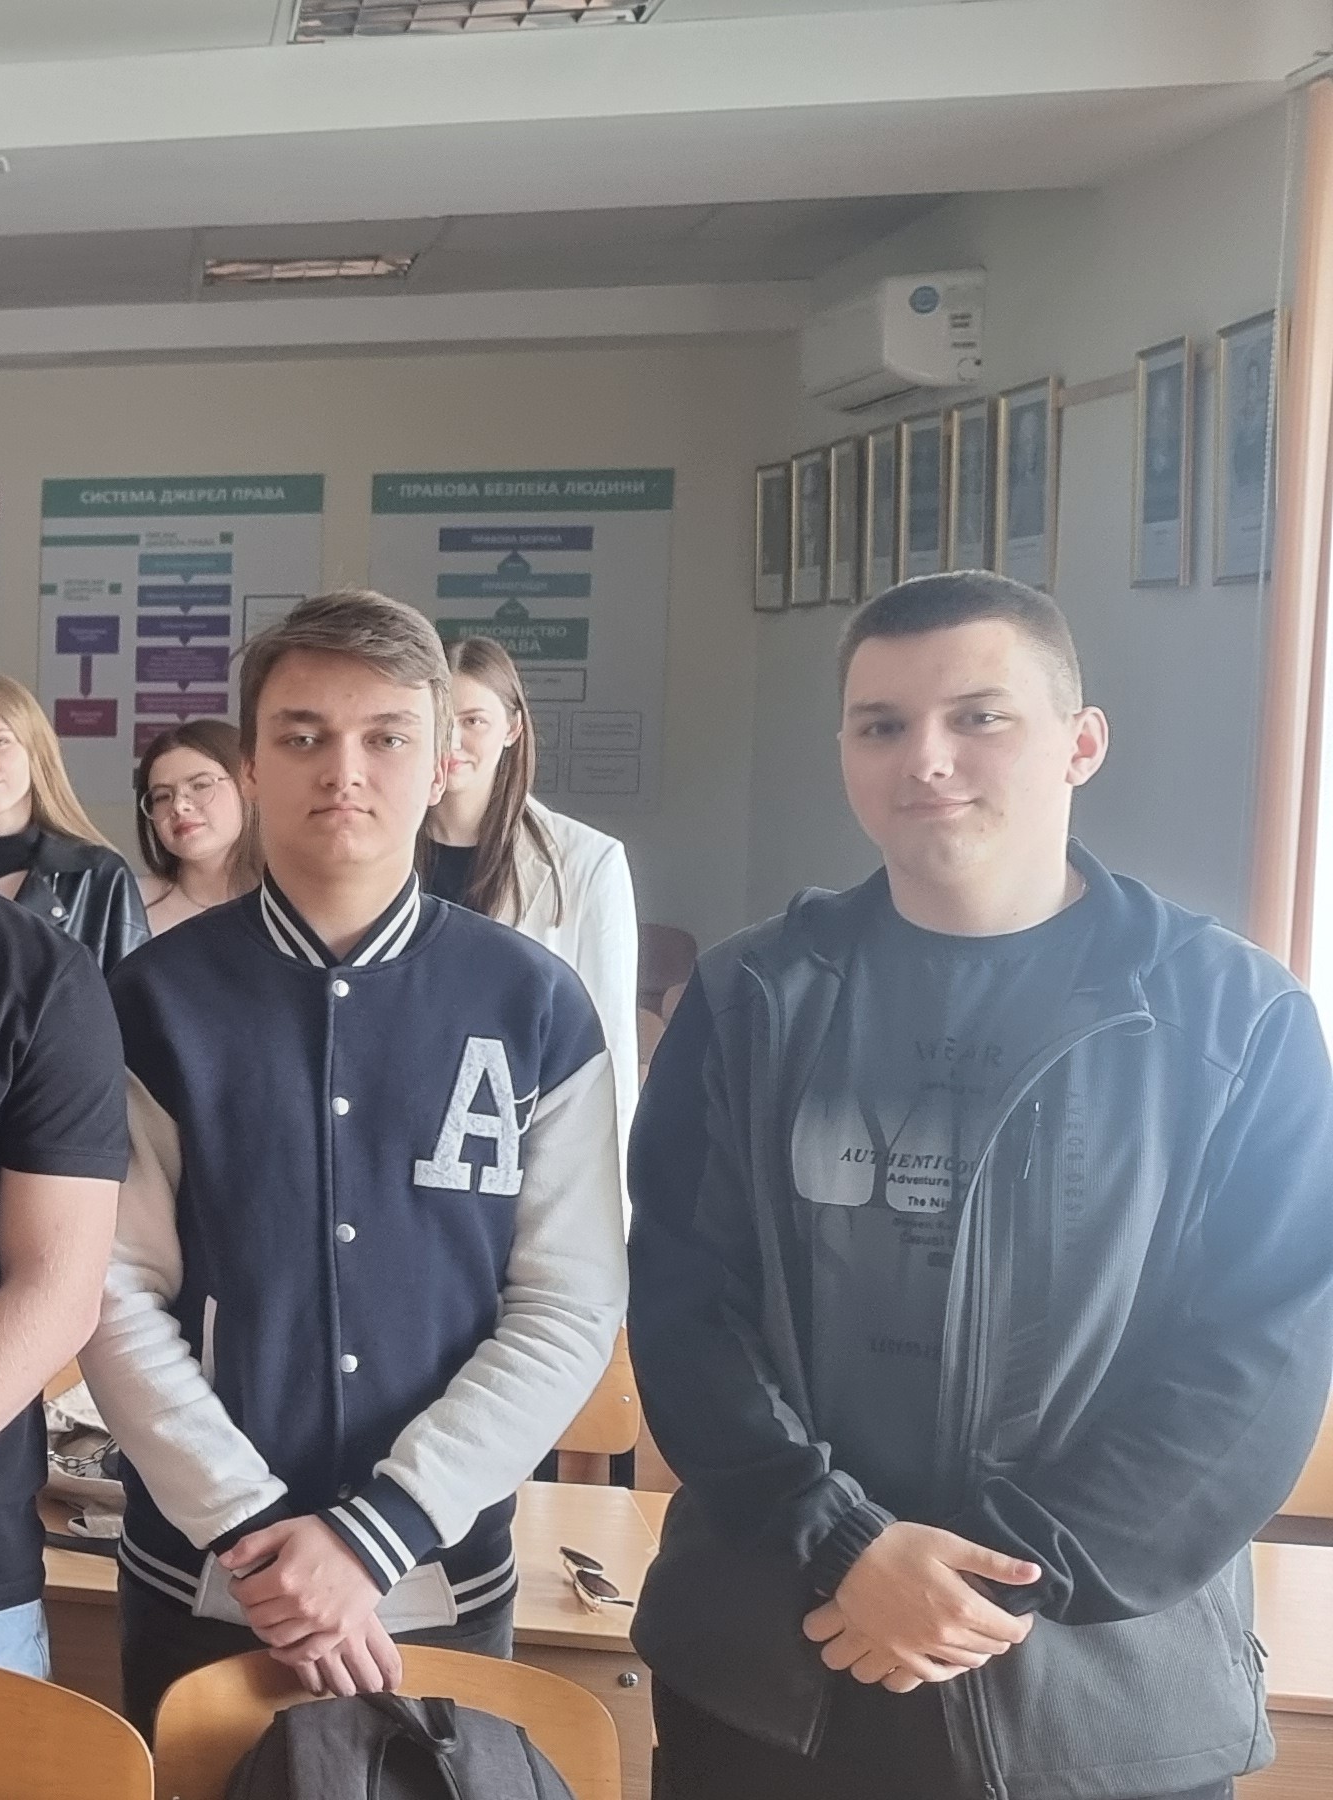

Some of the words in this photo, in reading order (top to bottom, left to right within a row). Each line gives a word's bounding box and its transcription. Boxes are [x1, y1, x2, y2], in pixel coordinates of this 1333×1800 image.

[80, 489, 156, 505] СИСТЕМА
[161, 488, 227, 505] ДЖЕРЕЛ
[233, 486, 285, 501] ПРАВА
[400, 482, 479, 498] ПРАВОВА
[484, 481, 560, 497] БЕЗПЕКА
[563, 479, 646, 498] ЛЮДИНИ
[413, 1036, 525, 1197] A
[887, 1173, 951, 1188] Adventure
